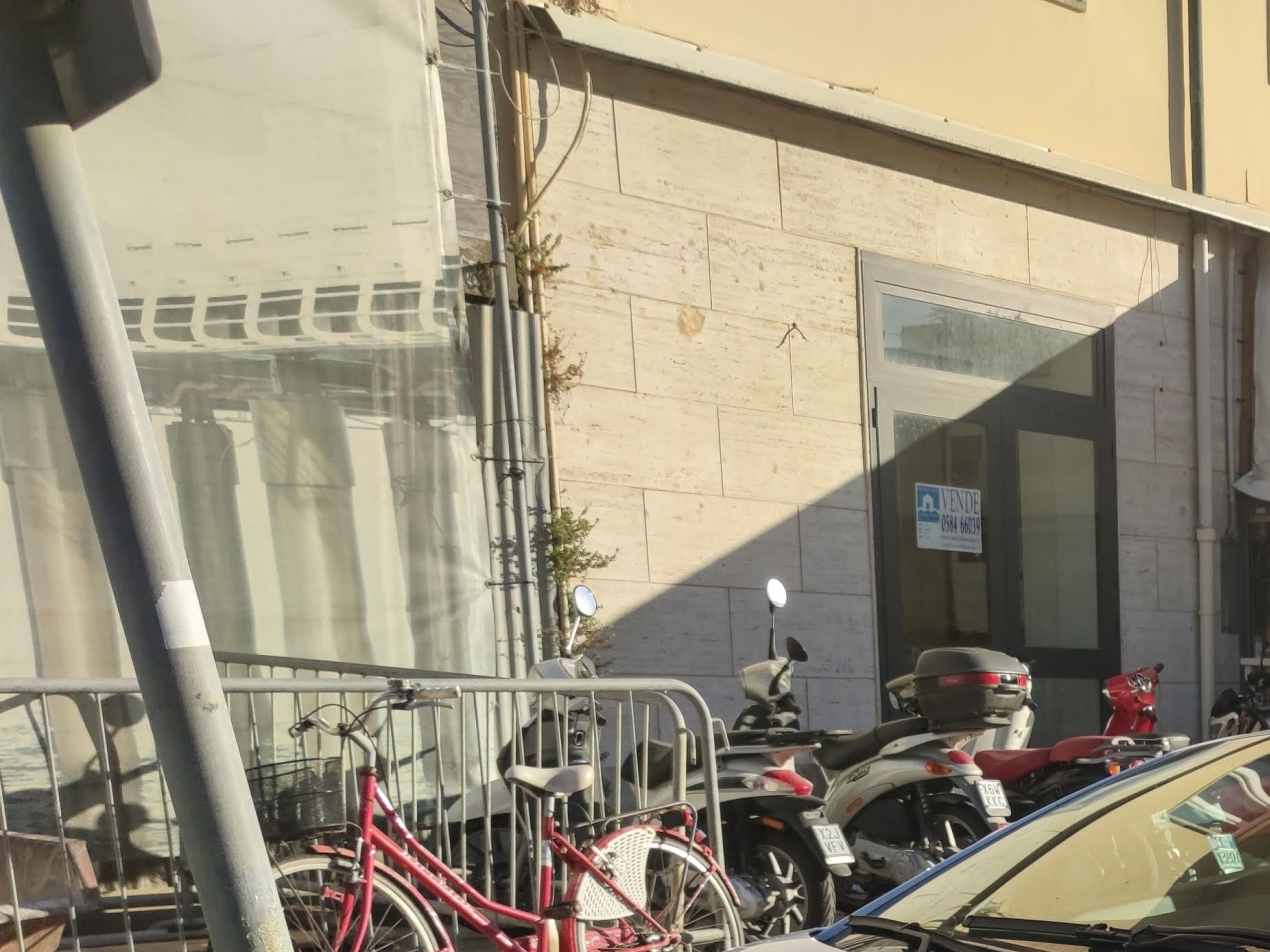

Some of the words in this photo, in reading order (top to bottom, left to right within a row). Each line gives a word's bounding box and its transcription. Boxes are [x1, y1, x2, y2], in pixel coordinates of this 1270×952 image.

[941, 488, 980, 515] VENDE
[941, 514, 957, 534] 0584
[818, 827, 841, 840] X2J
[824, 841, 845, 853] VFV
